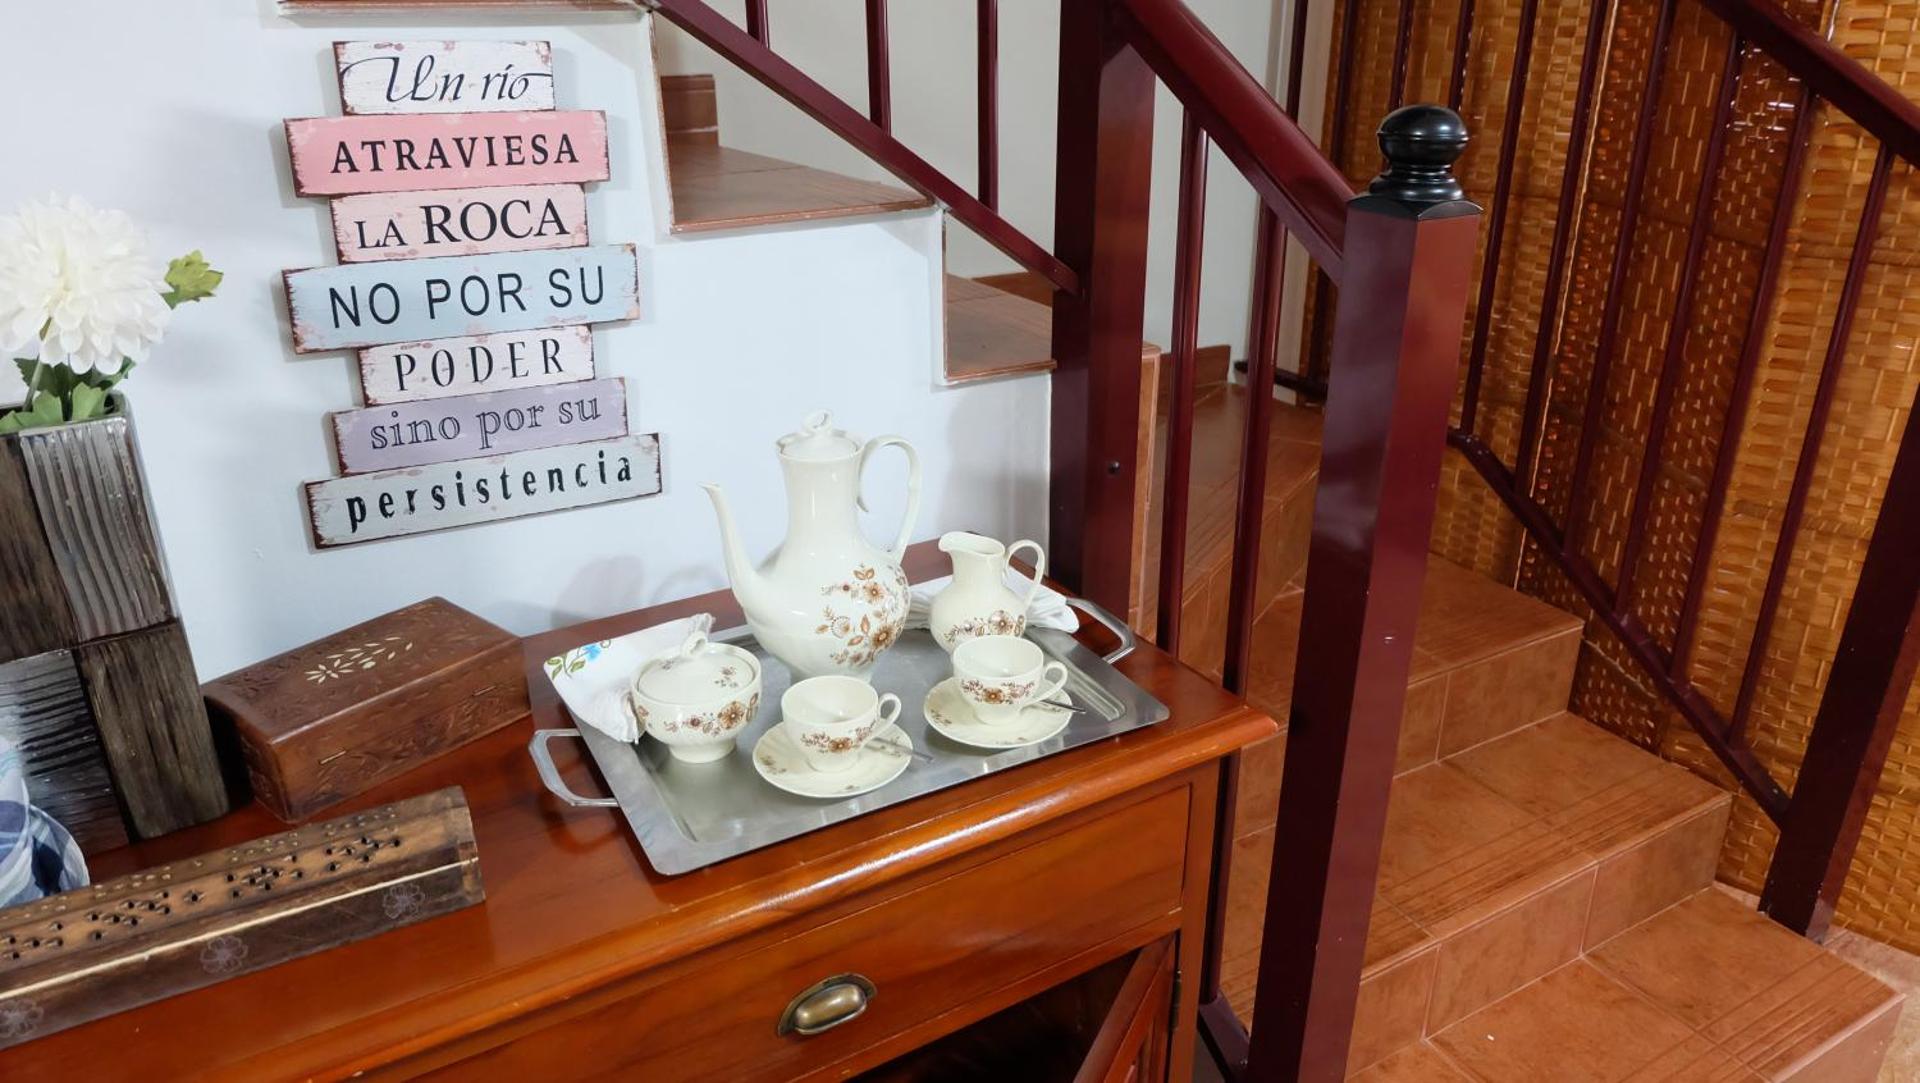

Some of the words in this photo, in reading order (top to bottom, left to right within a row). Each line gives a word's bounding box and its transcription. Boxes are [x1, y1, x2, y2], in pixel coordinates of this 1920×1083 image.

[340, 54, 465, 102] Un
[481, 64, 553, 100] río
[330, 133, 580, 174] ATRAVIESA
[354, 219, 408, 249] LA
[420, 198, 570, 244] ROCA
[329, 282, 401, 328] NO
[425, 273, 528, 319] POR
[548, 265, 605, 307] SU
[393, 338, 564, 392] PODER
[370, 411, 461, 450] sino
[476, 403, 545, 449] por
[558, 397, 601, 424] su
[346, 450, 632, 533] persistencia
